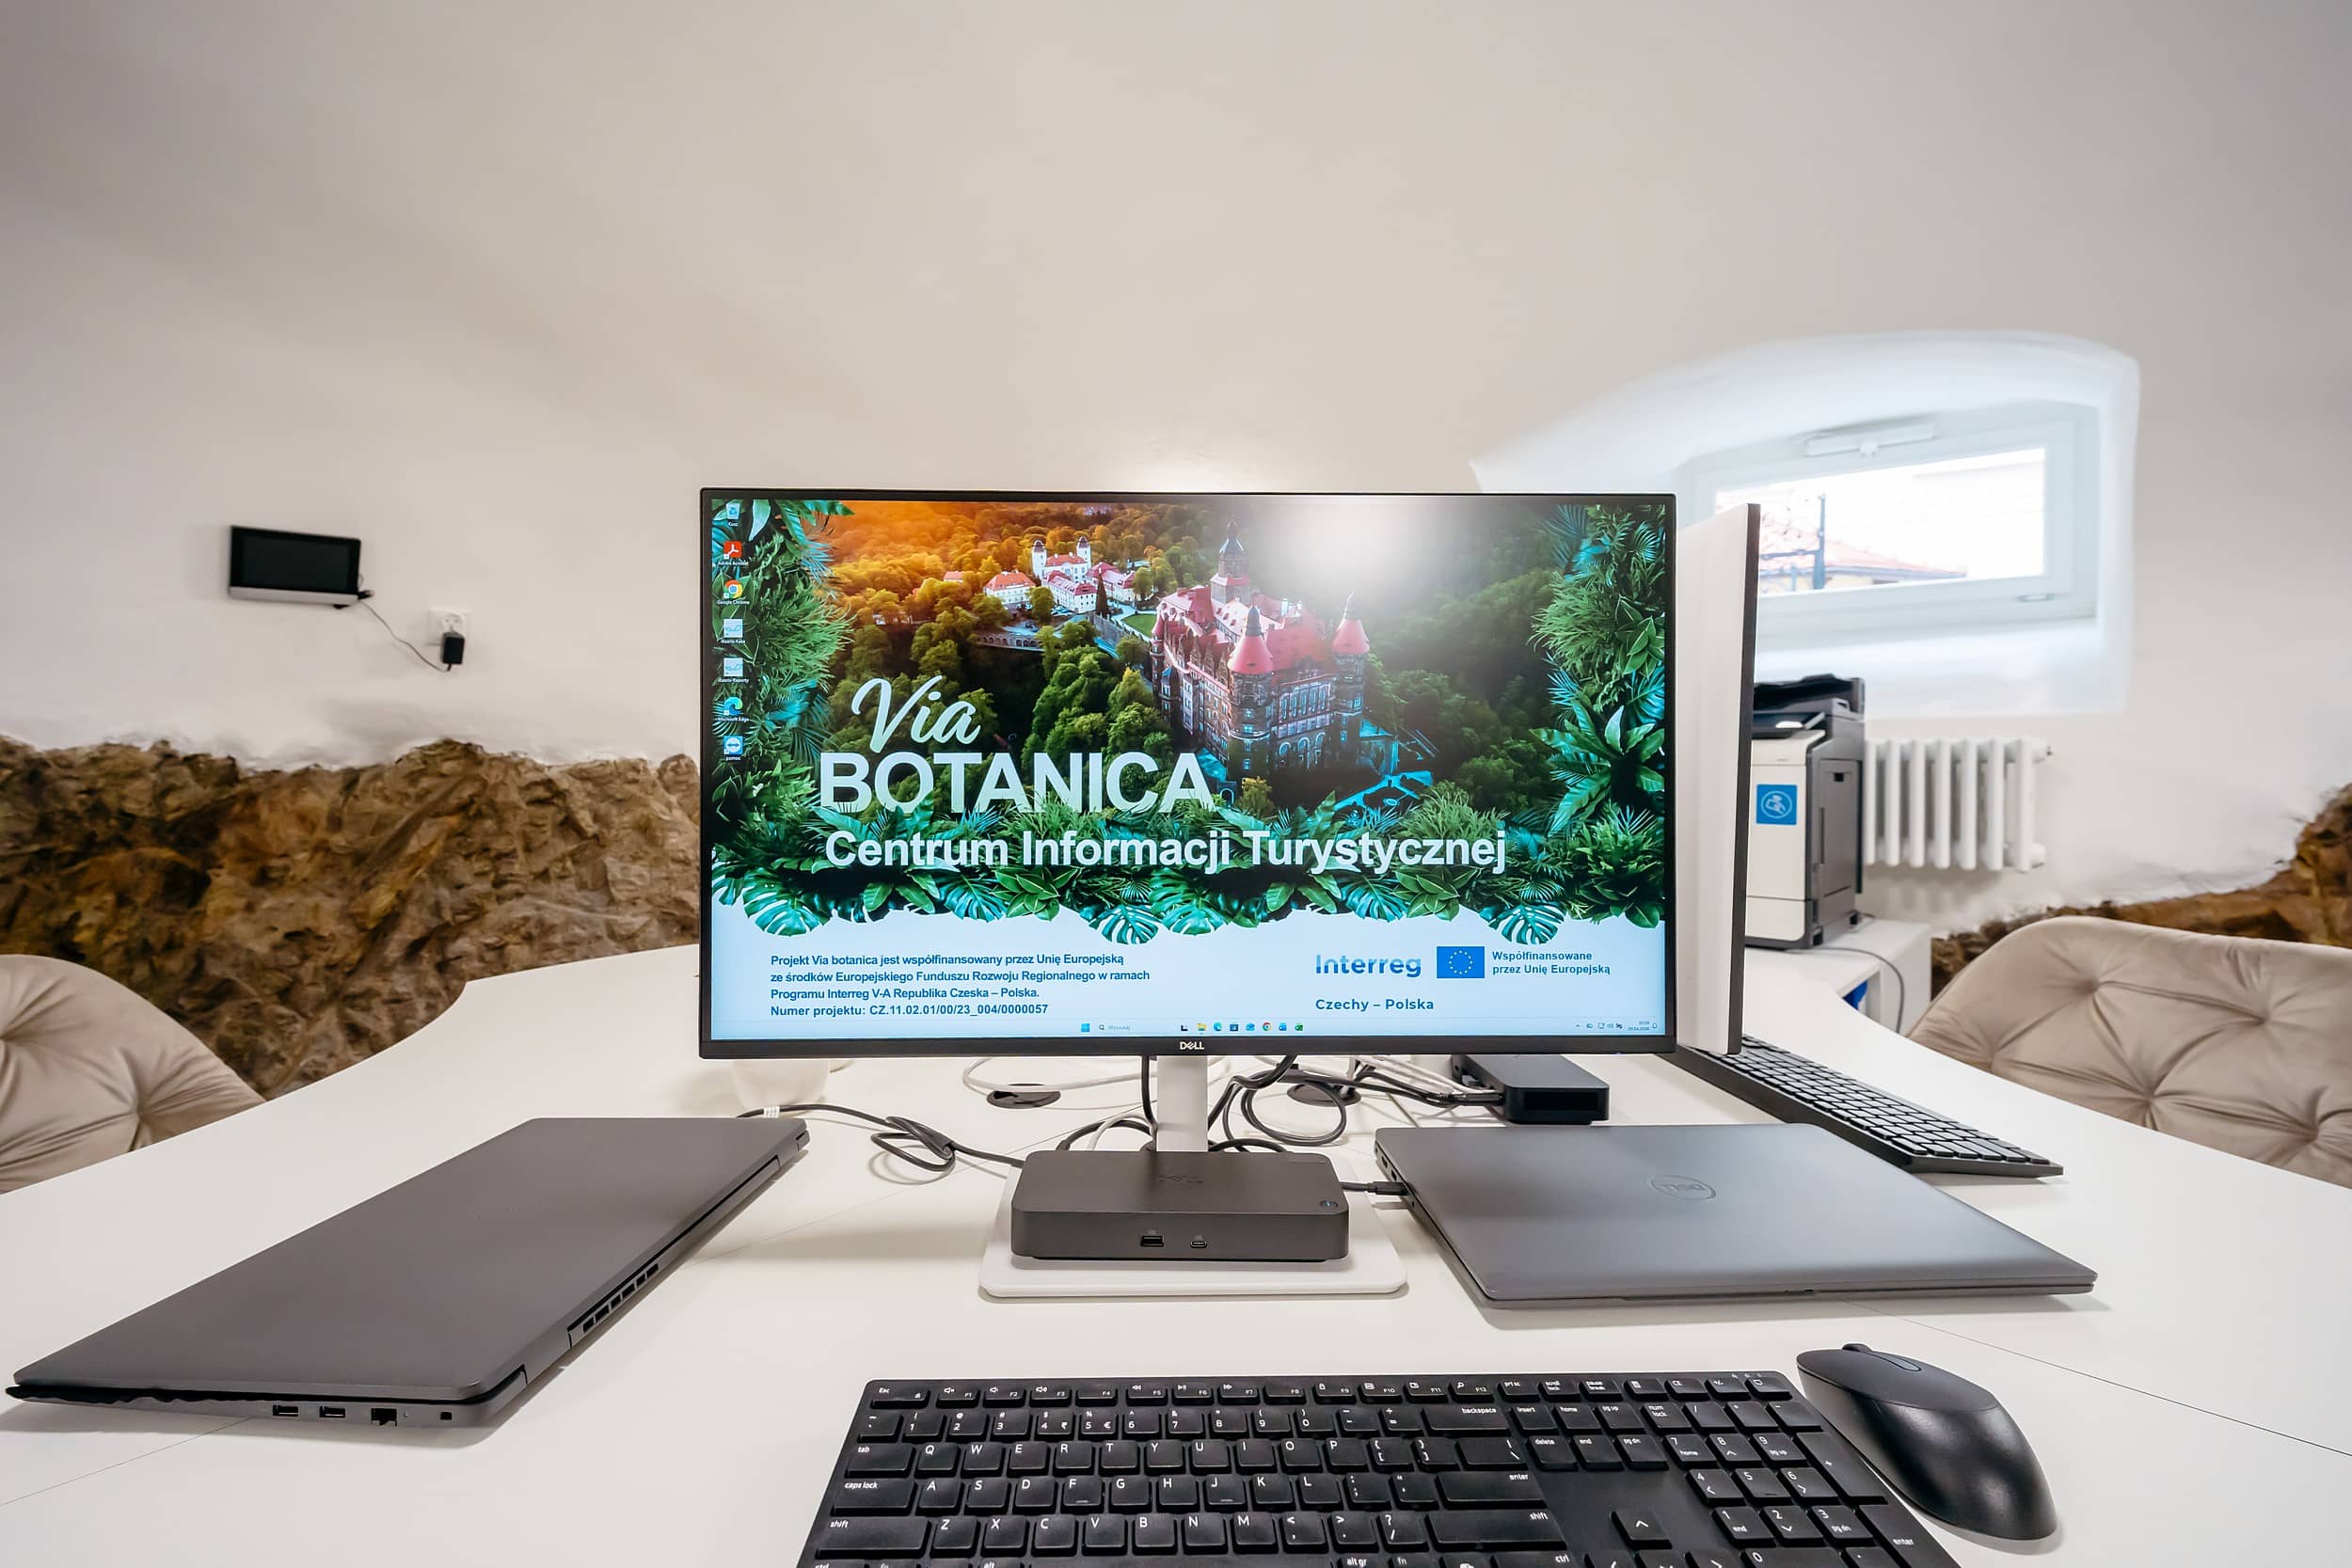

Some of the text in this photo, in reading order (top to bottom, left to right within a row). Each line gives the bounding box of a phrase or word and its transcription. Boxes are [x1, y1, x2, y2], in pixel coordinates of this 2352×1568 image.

[850, 675, 981, 752] Via
[819, 752, 1219, 815] BOTANICA
[825, 830, 1506, 876] Centrum Informacji Turystycznej
[771, 953, 1123, 968] Projekt Via botanica jest współfinansowany przez Unię Europejską
[1492, 950, 1593, 962] Współfinansowane
[1316, 955, 1422, 978] Interreg
[1492, 964, 1611, 976] przez Unię Europejską
[771, 970, 1151, 984] ze środków Europejskiego Funduszu Rozwoju Regionalnego w ramach
[771, 989, 824, 1002] Programu
[827, 988, 869, 1002] Interreg
[872, 988, 891, 999] V-A
[894, 988, 947, 1000] Republika
[950, 988, 989, 998] Czeska
[1001, 987, 1040, 998] Polska.
[771, 1004, 1049, 1019] Numer projektu: CZ.11.02.01/00/23_004/0000057
[1315, 998, 1369, 1013] Czechy
[1385, 998, 1434, 1010] Polska
[1180, 1041, 1205, 1051] DELL
[1009, 1391, 1020, 1400] F2
[845, 1482, 862, 1491] caps
[1530, 1512, 1548, 1520] shift
[831, 1519, 848, 1528] shift
[1347, 1557, 1367, 1568] alt gr
[1397, 1556, 1407, 1565] fn
[1555, 1554, 1569, 1563] ctrl
